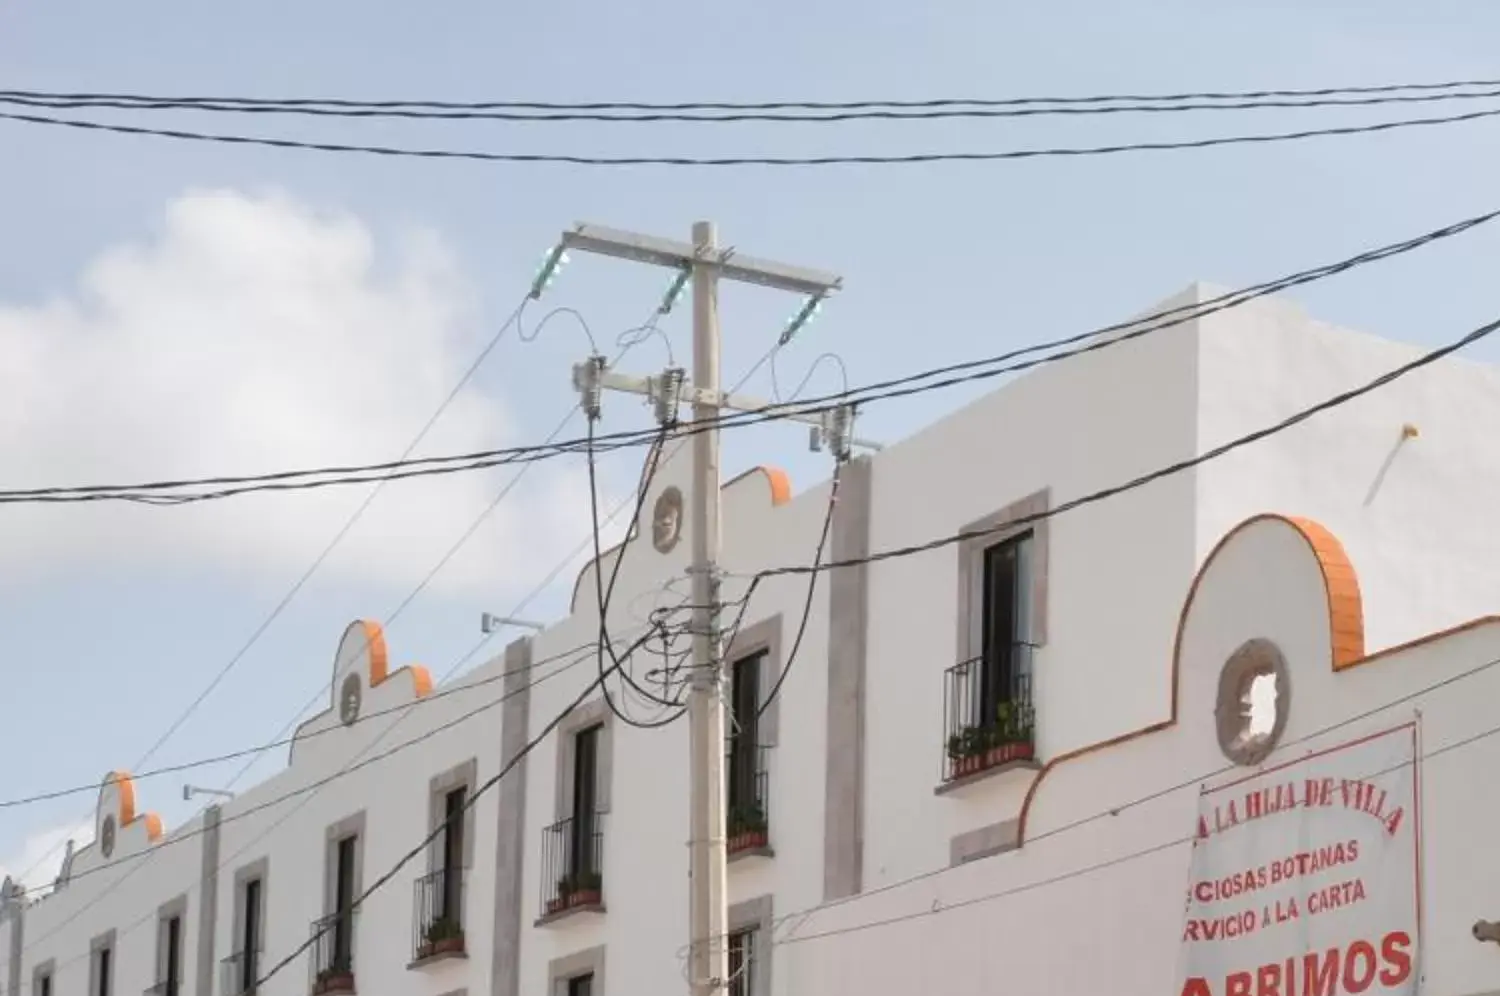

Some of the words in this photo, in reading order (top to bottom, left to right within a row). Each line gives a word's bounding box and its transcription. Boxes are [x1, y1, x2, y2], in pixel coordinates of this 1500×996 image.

[1214, 799, 1239, 833] LA
[1245, 781, 1297, 821] HIJA
[1303, 777, 1334, 807] DE
[1340, 777, 1404, 836] VILLA
[1271, 839, 1358, 884] BOTANAS
[1261, 906, 1271, 929] A
[1276, 897, 1298, 924] LA
[1307, 879, 1365, 915] CARTA
